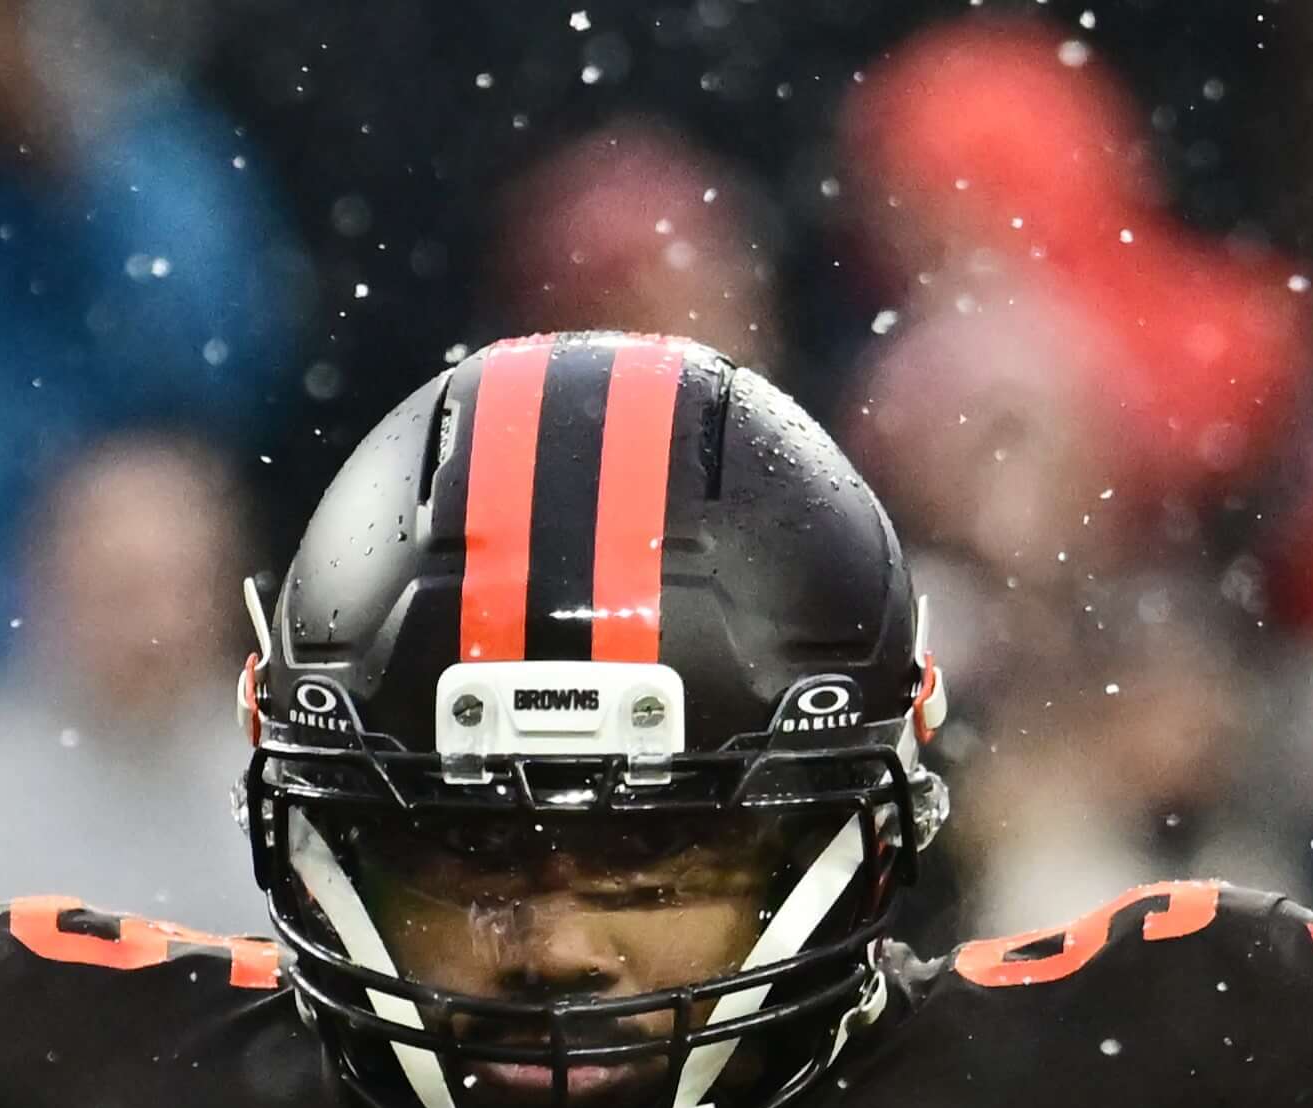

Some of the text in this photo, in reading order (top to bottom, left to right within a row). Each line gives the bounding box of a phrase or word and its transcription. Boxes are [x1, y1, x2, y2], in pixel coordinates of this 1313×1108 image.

[514, 688, 600, 711] BROWNS
[289, 709, 348, 732] OAKLEY
[782, 711, 862, 732] OAKLEY
